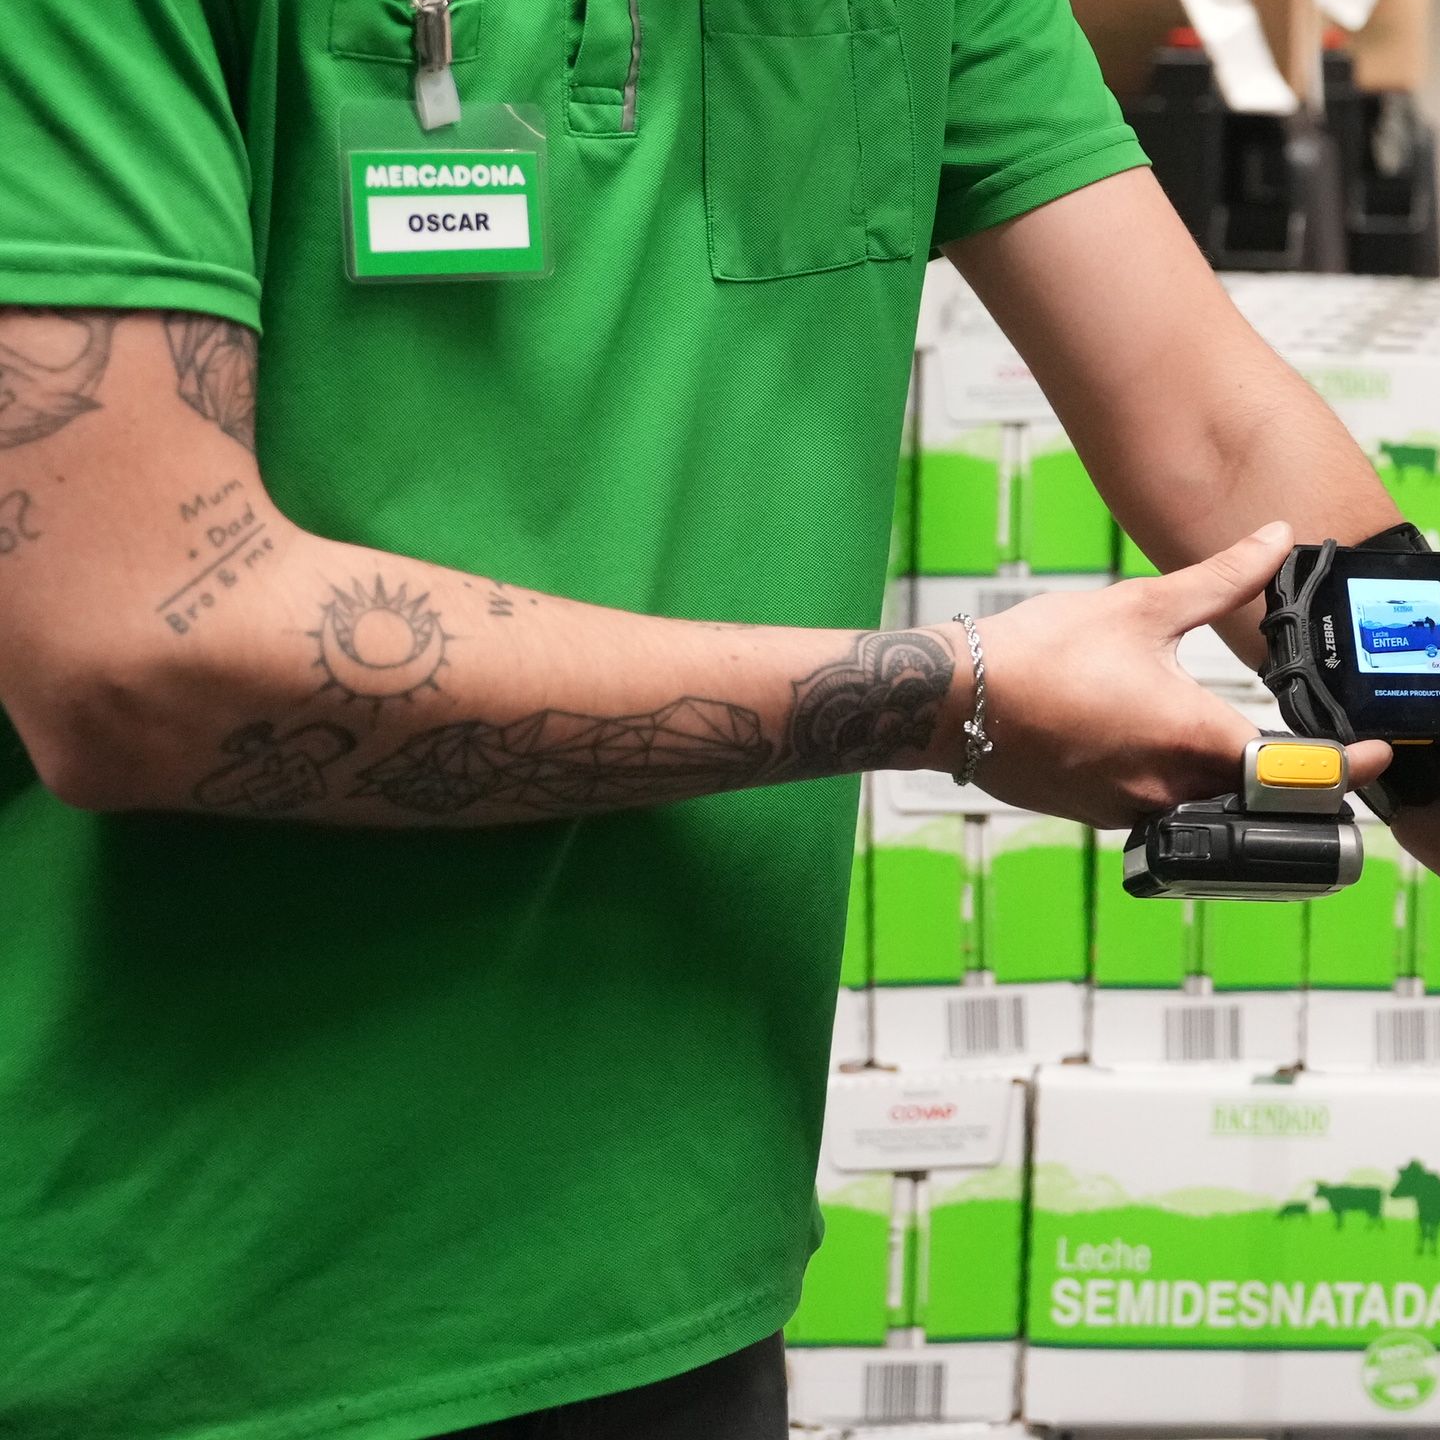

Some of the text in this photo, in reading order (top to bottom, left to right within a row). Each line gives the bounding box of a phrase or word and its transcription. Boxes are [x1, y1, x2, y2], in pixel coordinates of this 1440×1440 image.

[365, 164, 526, 189] MERCADONA
[408, 212, 490, 233] OSCAR
[179, 478, 243, 523] Mum
[206, 502, 256, 547] Dad
[165, 591, 216, 636] Bro
[1322, 614, 1337, 652] ZEBRA
[1373, 638, 1410, 648] ENTERA
[1374, 689, 1409, 697] ESCANEAR
[1056, 1237, 1151, 1273] Leche
